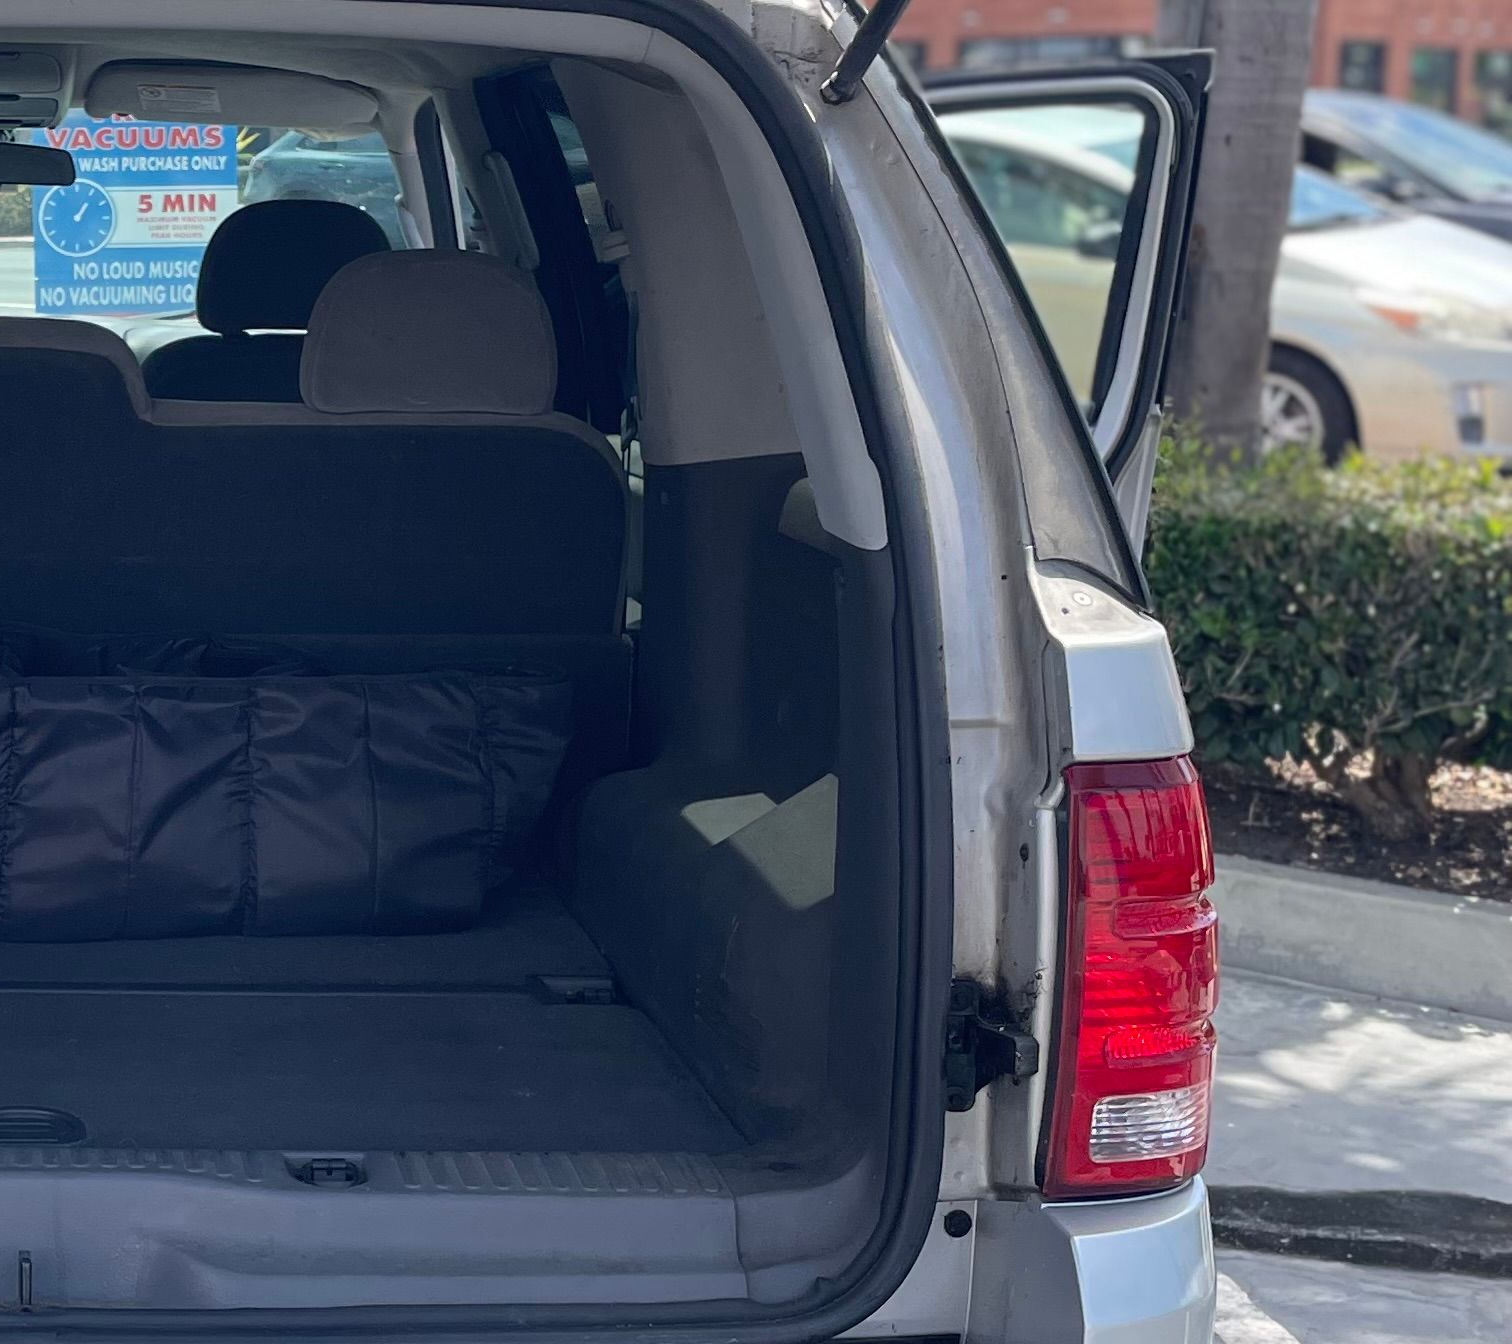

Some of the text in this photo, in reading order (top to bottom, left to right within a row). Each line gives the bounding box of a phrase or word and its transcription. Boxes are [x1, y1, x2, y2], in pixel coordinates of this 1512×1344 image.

[45, 125, 224, 150] VACUUMS
[79, 155, 227, 172] WASH PURCHASE ONLY
[138, 193, 216, 213] 5 MIN
[73, 260, 199, 280] NO LOUD MUSIC
[40, 288, 65, 306] NO
[69, 285, 167, 305] VACUUMING
